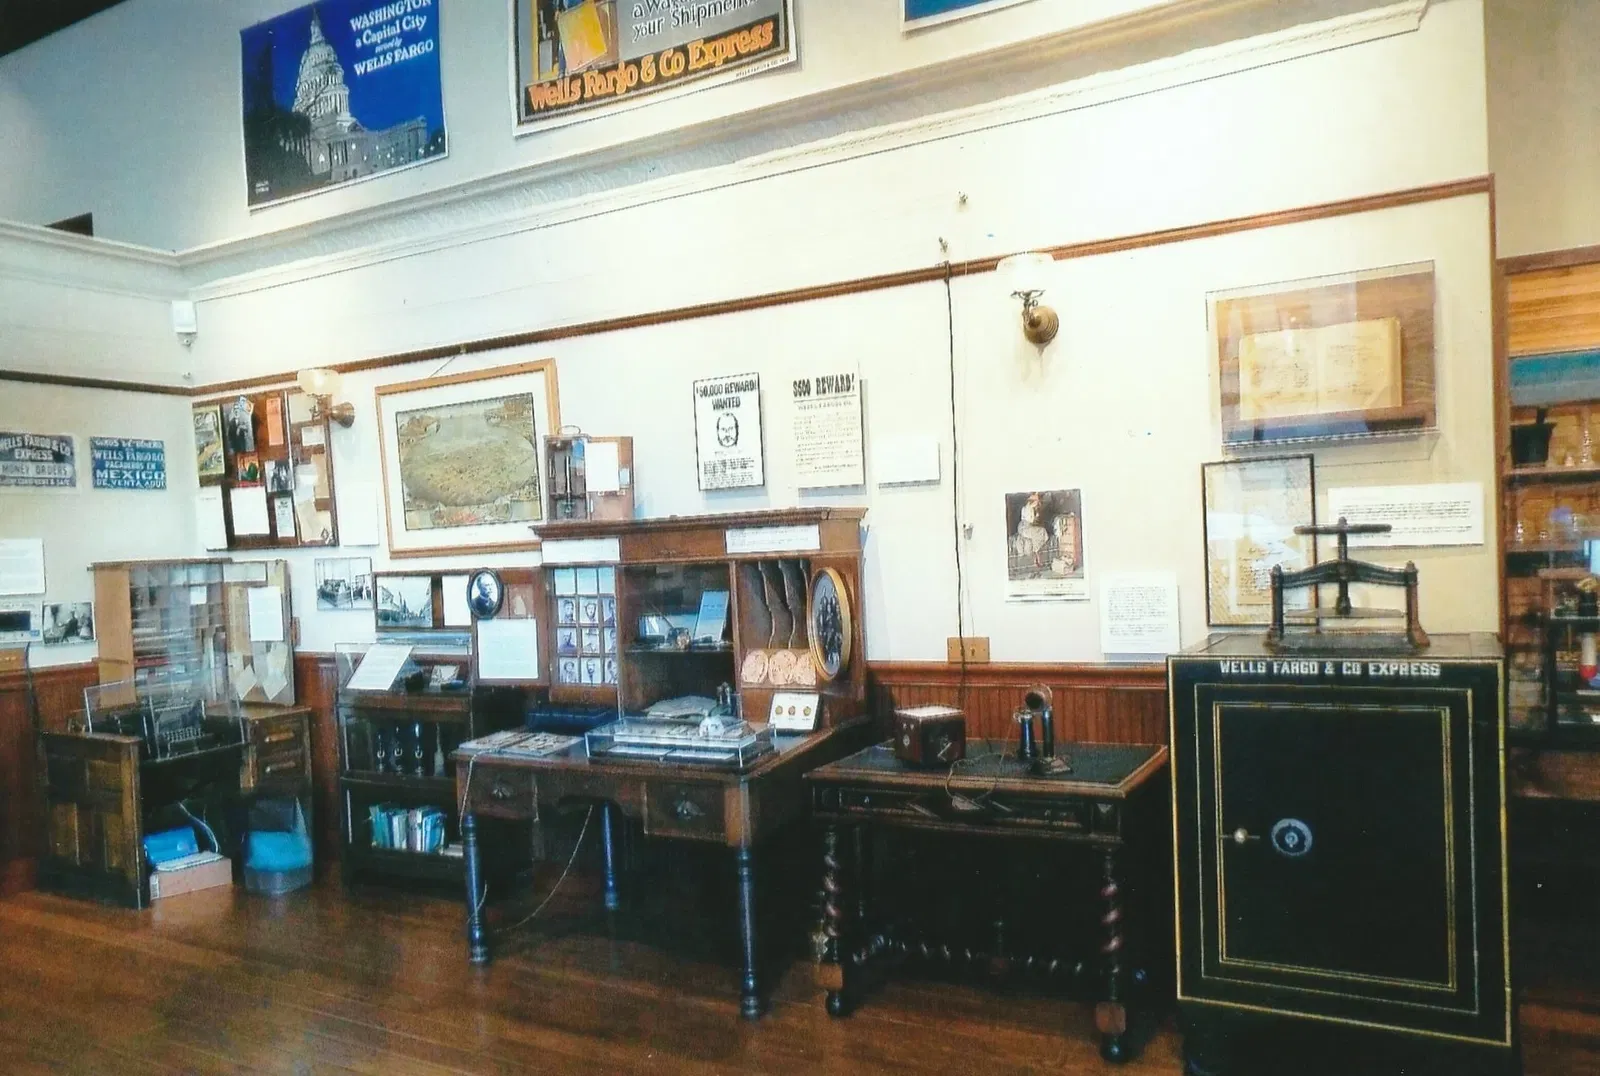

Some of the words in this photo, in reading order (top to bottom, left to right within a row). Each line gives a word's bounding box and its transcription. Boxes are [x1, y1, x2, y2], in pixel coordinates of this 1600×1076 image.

[633, 3, 645, 18] a
[355, 38, 362, 48] a
[362, 19, 400, 44] Capital
[402, 14, 427, 31] City
[632, 17, 665, 43] your
[353, 52, 393, 76] WELLS
[394, 39, 434, 62] FARGO
[528, 76, 581, 111] Wells
[583, 60, 638, 98] Fargo
[640, 54, 656, 82] &
[659, 49, 685, 76] Co
[688, 20, 774, 69] Express
[816, 372, 855, 395] REWARD!
[712, 396, 741, 410] WANTED
[24, 434, 51, 449] FARGO
[15, 448, 53, 460] EXPRESS
[94, 449, 124, 460] WELLS
[35, 464, 68, 476] ORDERS
[96, 469, 165, 480] MEXICO
[1220, 660, 1267, 673] WELLS
[1273, 661, 1319, 674] FARGO
[1324, 662, 1336, 674] &
[1342, 661, 1361, 674] CO
[1368, 662, 1441, 676] EXPRESS
